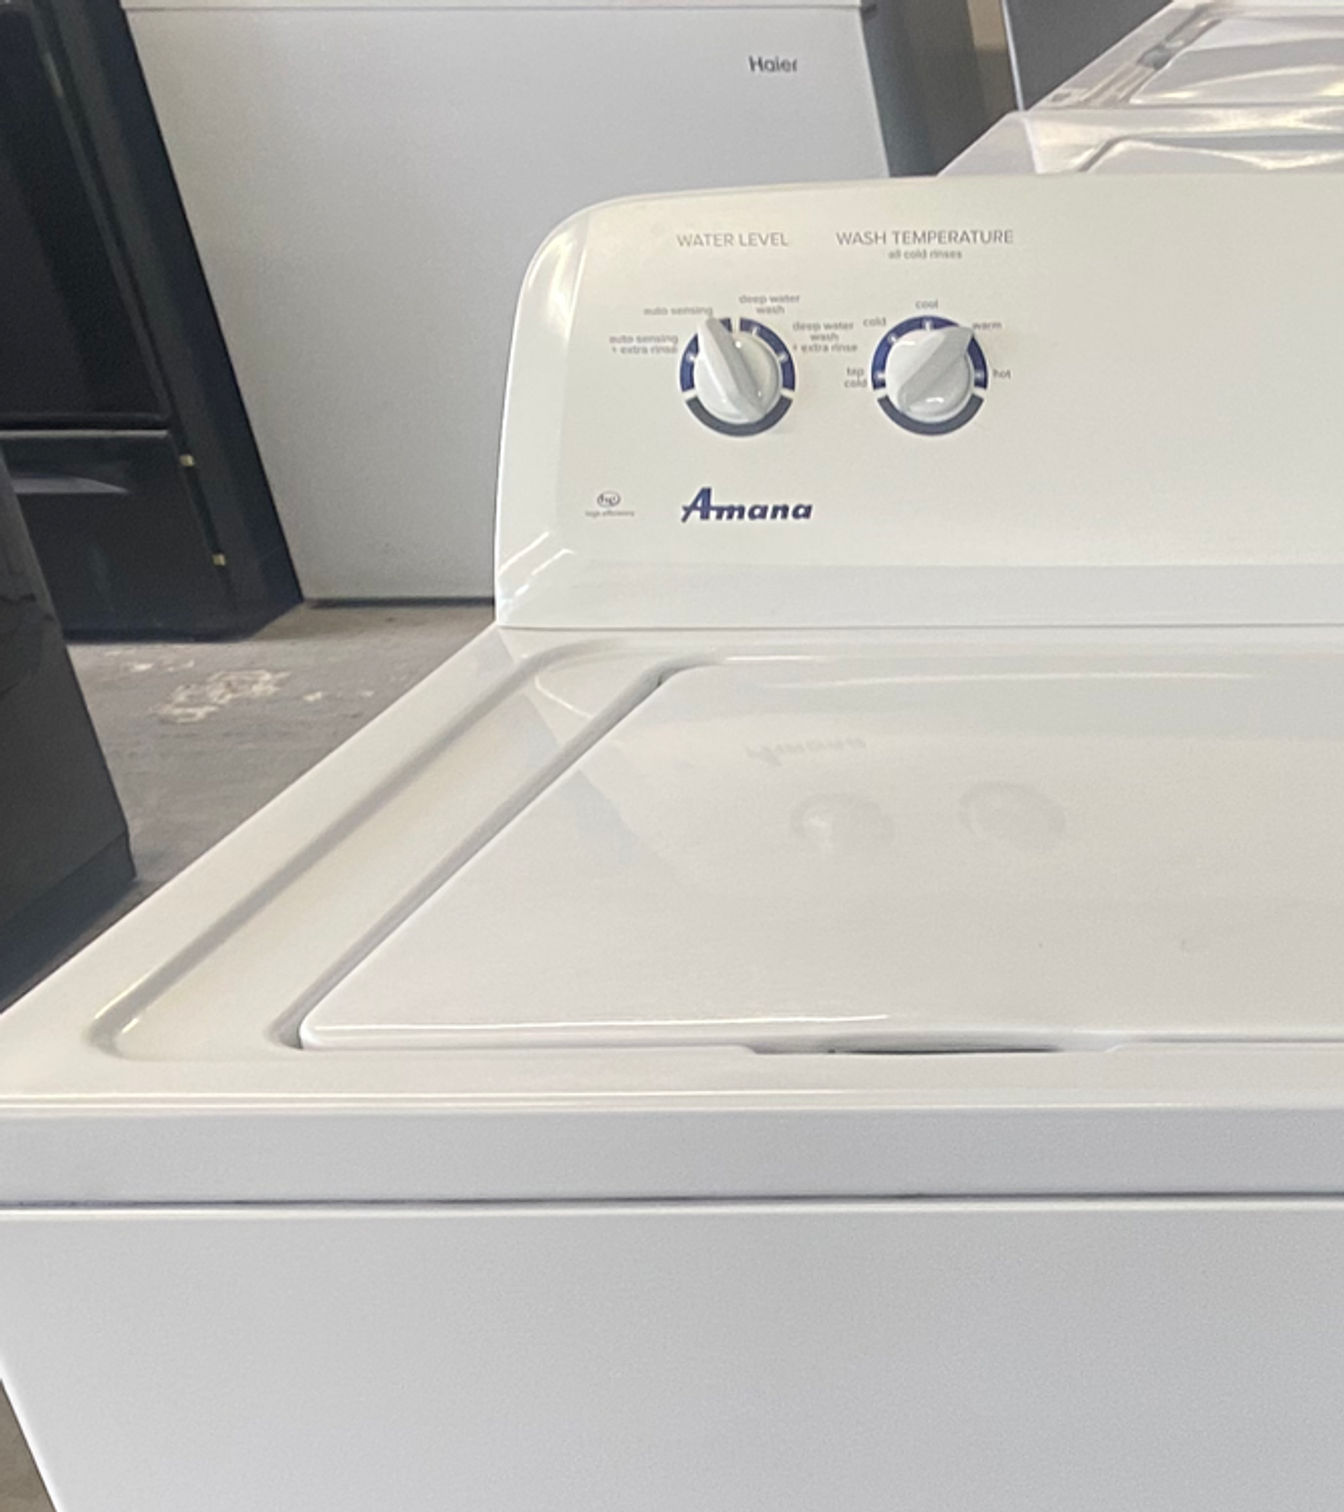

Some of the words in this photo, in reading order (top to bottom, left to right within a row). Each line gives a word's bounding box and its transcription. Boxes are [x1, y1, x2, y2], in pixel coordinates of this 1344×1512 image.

[748, 55, 798, 72] Haier
[676, 231, 734, 247] WATER
[738, 231, 789, 247] LEVEL
[836, 231, 886, 245] WASH
[891, 230, 1014, 245] TEMPERATURE
[888, 250, 900, 259] all
[903, 249, 926, 259] cold
[929, 249, 962, 259] rinses
[739, 295, 767, 305] deep
[770, 295, 800, 304] water
[915, 300, 939, 309] cool
[643, 307, 668, 315] auto
[670, 306, 714, 317] sensing
[756, 305, 785, 314] wash
[793, 322, 821, 331] deep
[823, 322, 854, 331] water
[863, 317, 886, 327] cold
[972, 321, 1002, 330] warm
[609, 336, 634, 344] auto
[636, 334, 678, 345] sensing
[810, 332, 839, 342] wash
[620, 345, 647, 354] extra
[650, 345, 678, 354] rinse
[801, 343, 829, 352] extra
[831, 343, 858, 352] rinse
[847, 368, 864, 378] tap
[993, 369, 1011, 379] hot
[844, 378, 867, 387] cold
[681, 487, 813, 524] Amana
